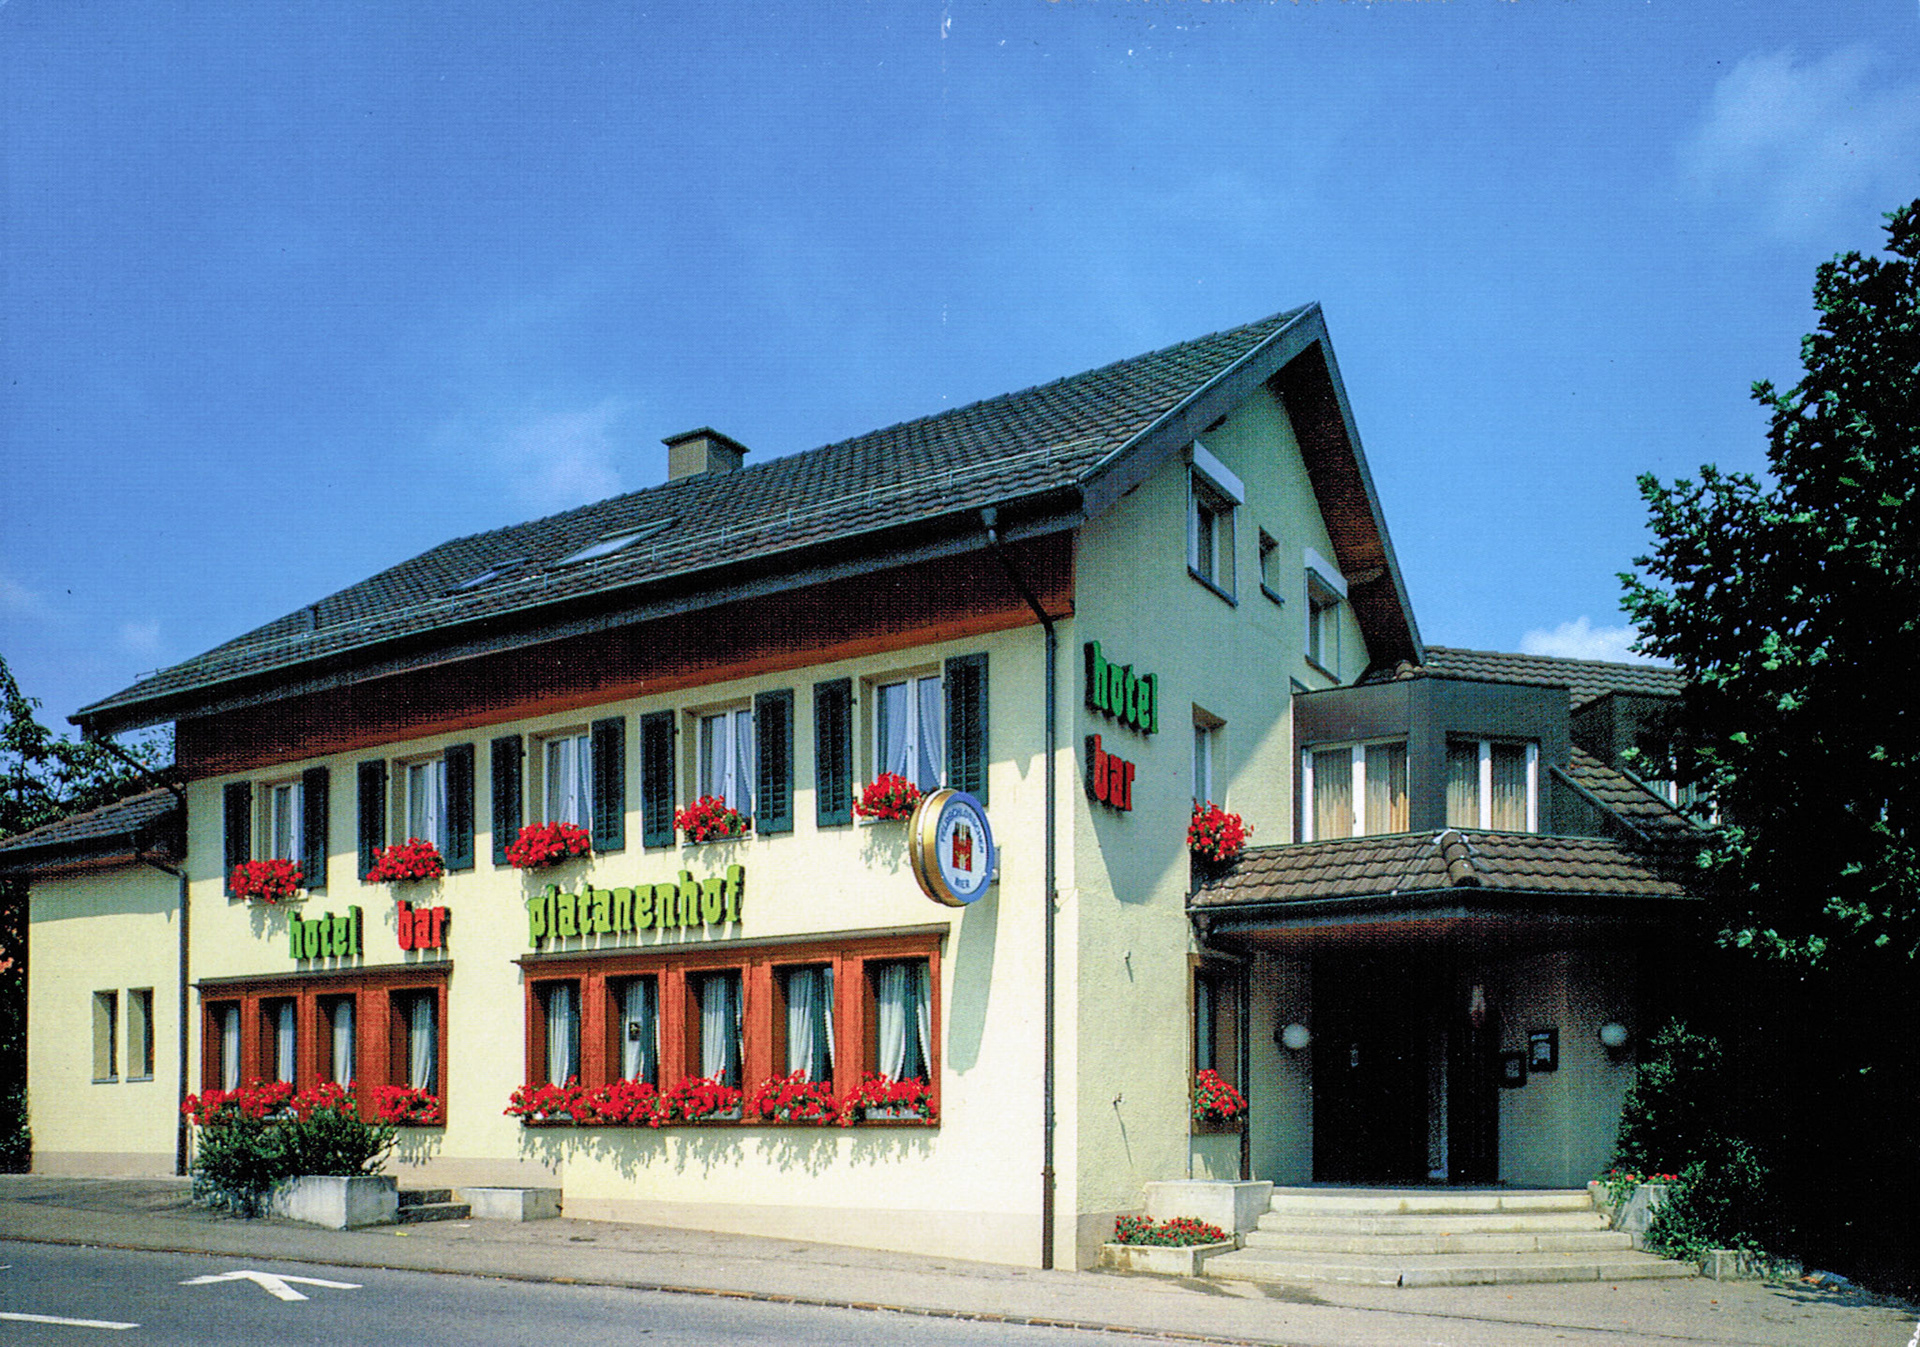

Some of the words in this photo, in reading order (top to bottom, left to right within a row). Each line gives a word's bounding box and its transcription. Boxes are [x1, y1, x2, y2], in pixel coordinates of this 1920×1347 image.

[1090, 640, 1158, 734] hotel
[1092, 734, 1135, 811] bar
[288, 905, 359, 959] hotel
[397, 900, 448, 950] bar
[528, 865, 743, 948] platanenhof
